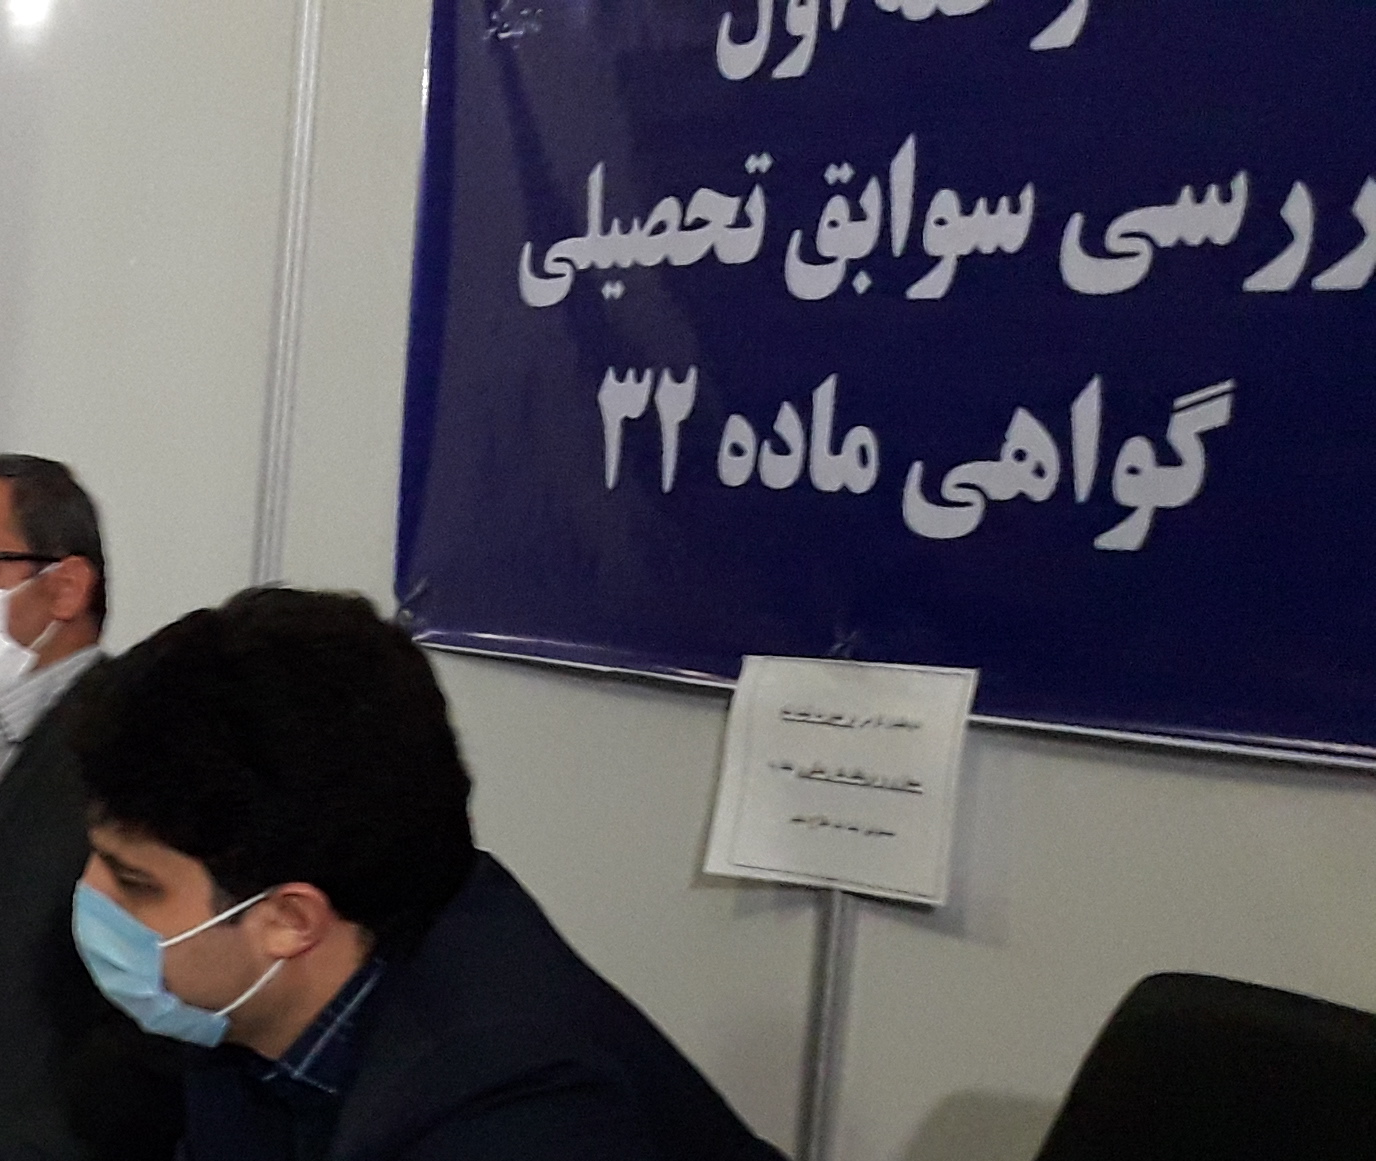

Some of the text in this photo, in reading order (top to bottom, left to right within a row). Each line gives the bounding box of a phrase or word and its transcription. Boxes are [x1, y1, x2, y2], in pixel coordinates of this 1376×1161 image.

[517, 134, 1376, 308] ررسی سوابق تحصیلی
[597, 364, 1237, 552] گواهی ماده ۳۲
